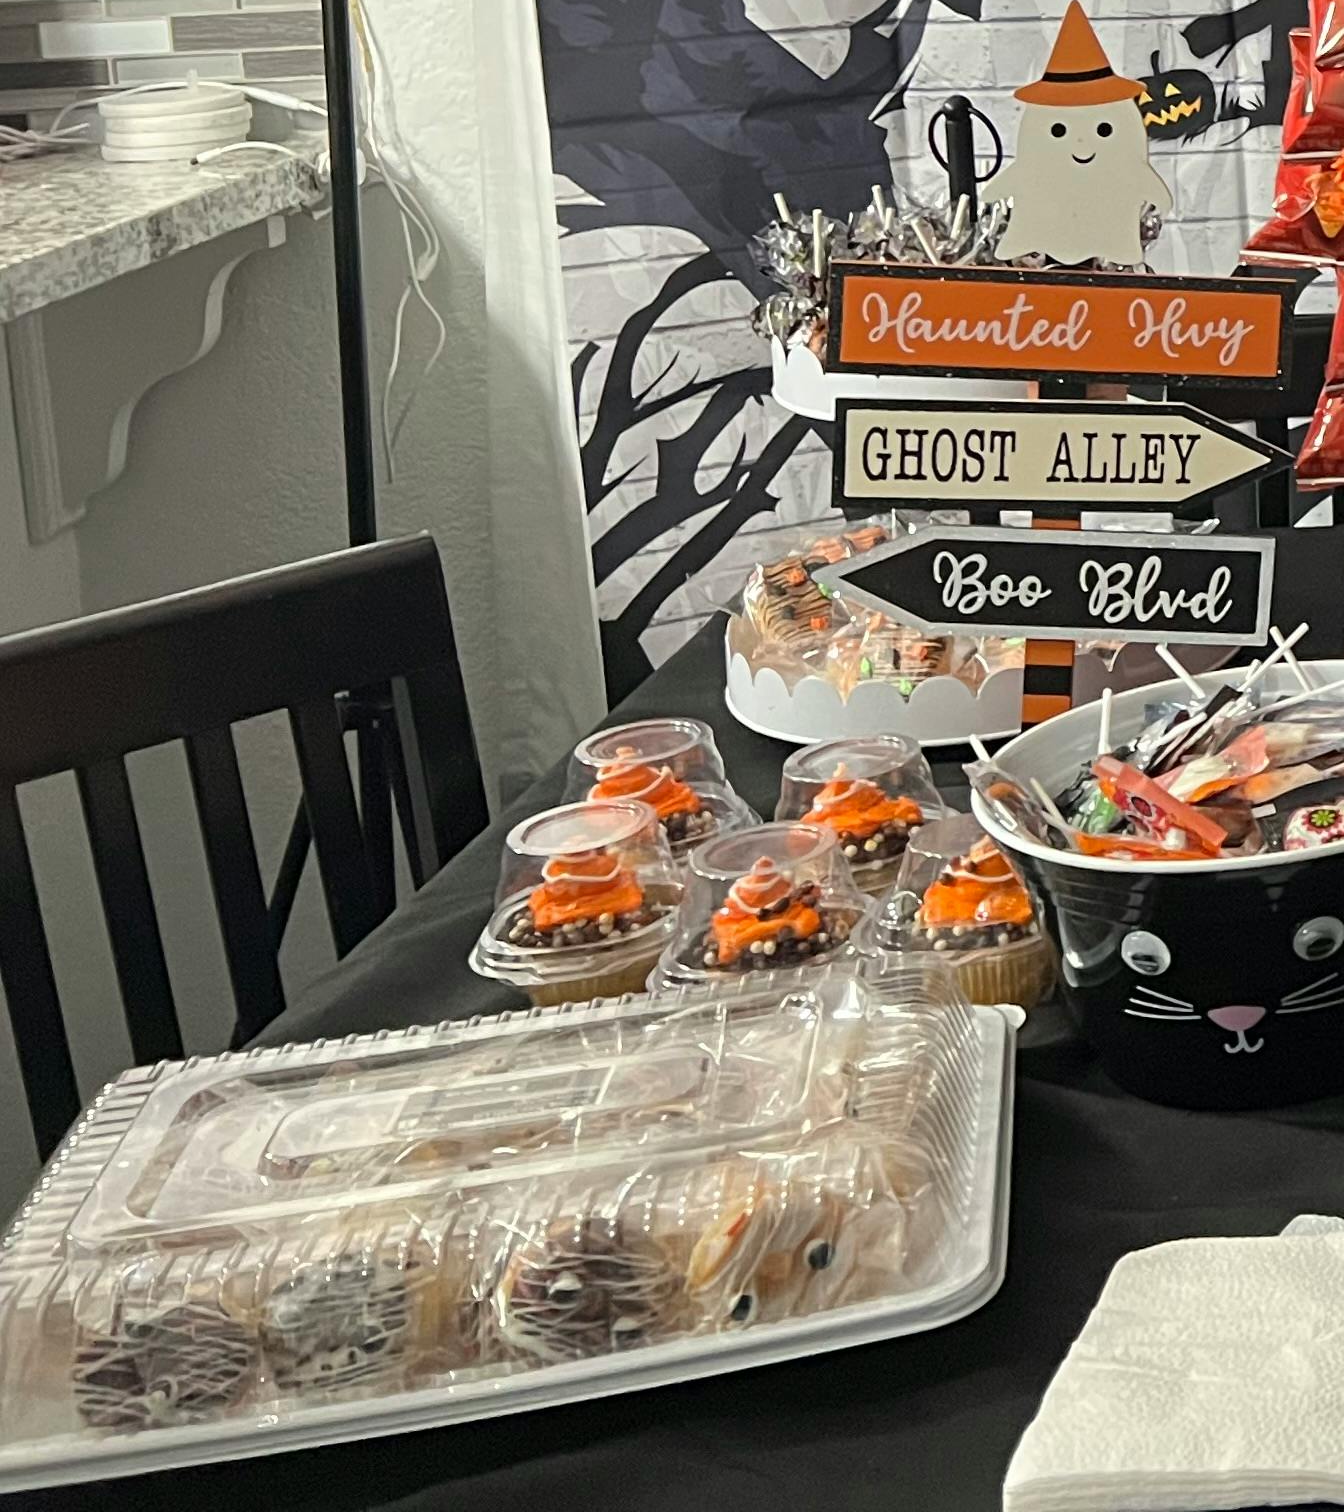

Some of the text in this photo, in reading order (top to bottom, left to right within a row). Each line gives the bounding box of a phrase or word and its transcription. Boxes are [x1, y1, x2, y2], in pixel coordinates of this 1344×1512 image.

[861, 291, 1255, 366] Haunted Hwy
[861, 427, 1202, 485] GHOST ALLEY
[932, 549, 1233, 625] Boo Blvd
